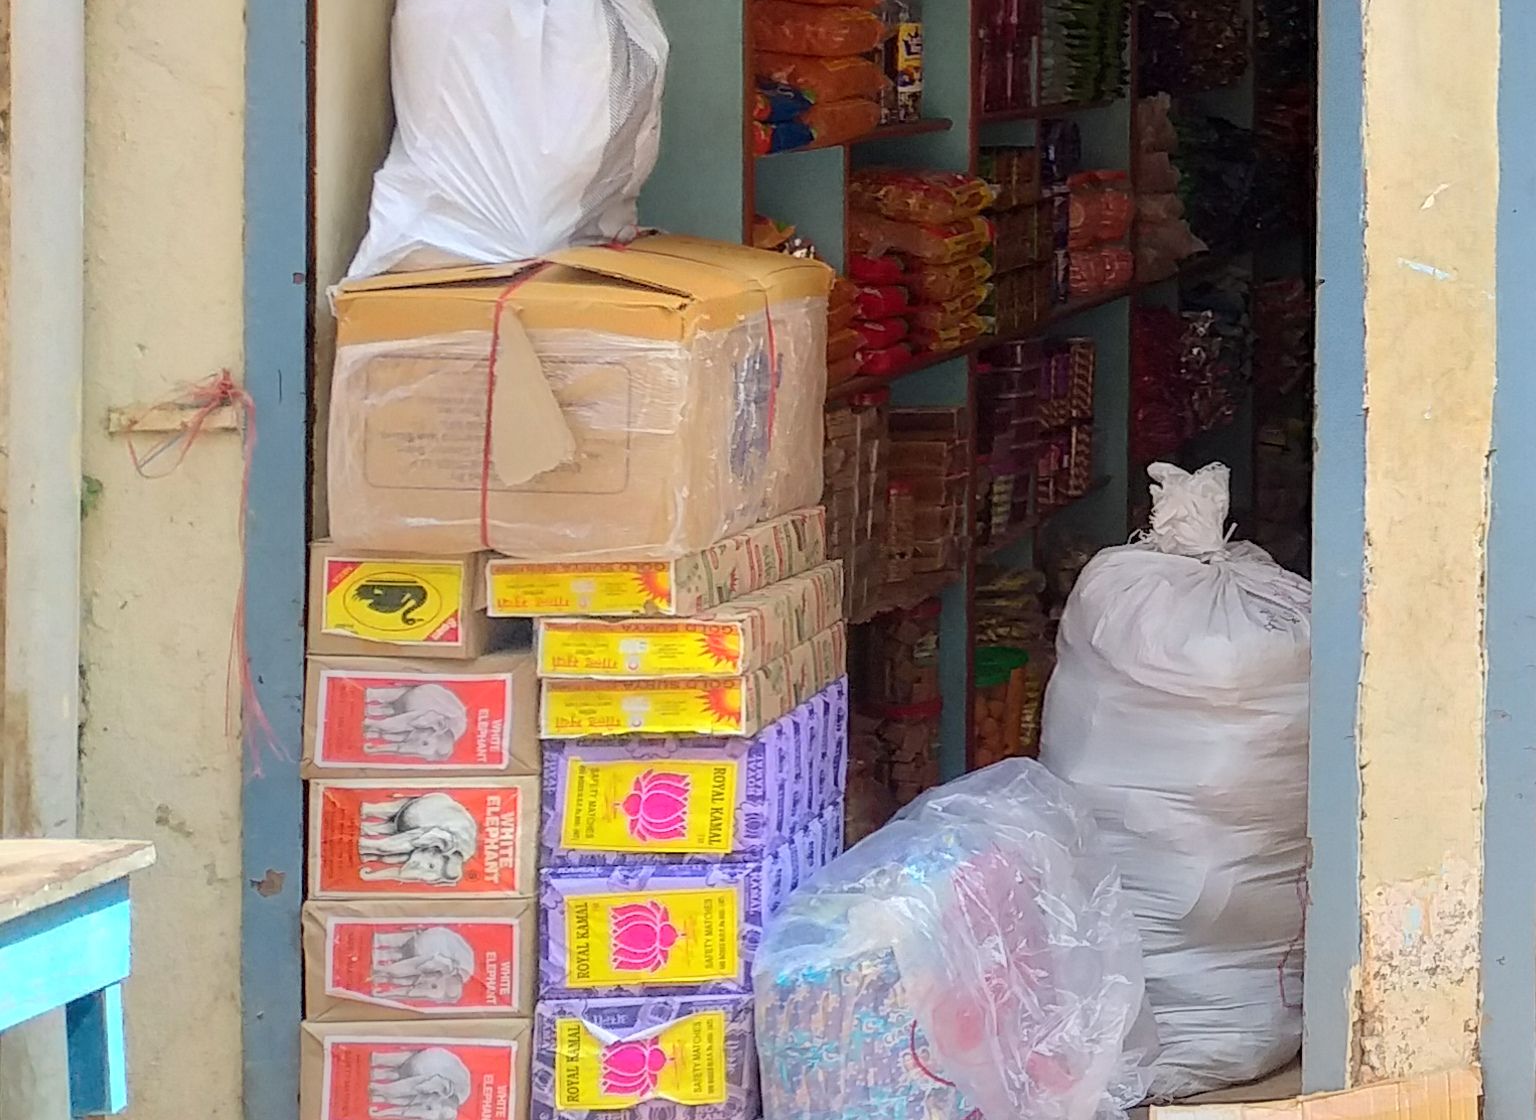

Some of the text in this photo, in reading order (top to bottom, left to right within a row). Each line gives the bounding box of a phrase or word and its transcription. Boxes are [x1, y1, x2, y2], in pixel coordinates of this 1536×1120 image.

[475, 707, 489, 763] ELEPHANT
[489, 718, 502, 753] WHITE
[708, 766, 727, 846] ROYAL KAMAL
[484, 795, 501, 883] ELEPHANT
[500, 811, 516, 869] WHITE
[574, 902, 590, 979] ROYAL KAMAL
[485, 951, 498, 1006] ELEPHANT
[499, 961, 512, 997] WHITE
[481, 1073, 494, 1120] ELEPHAN
[495, 1084, 508, 1119] WHITE
[566, 1066, 581, 1103] ROYAL
